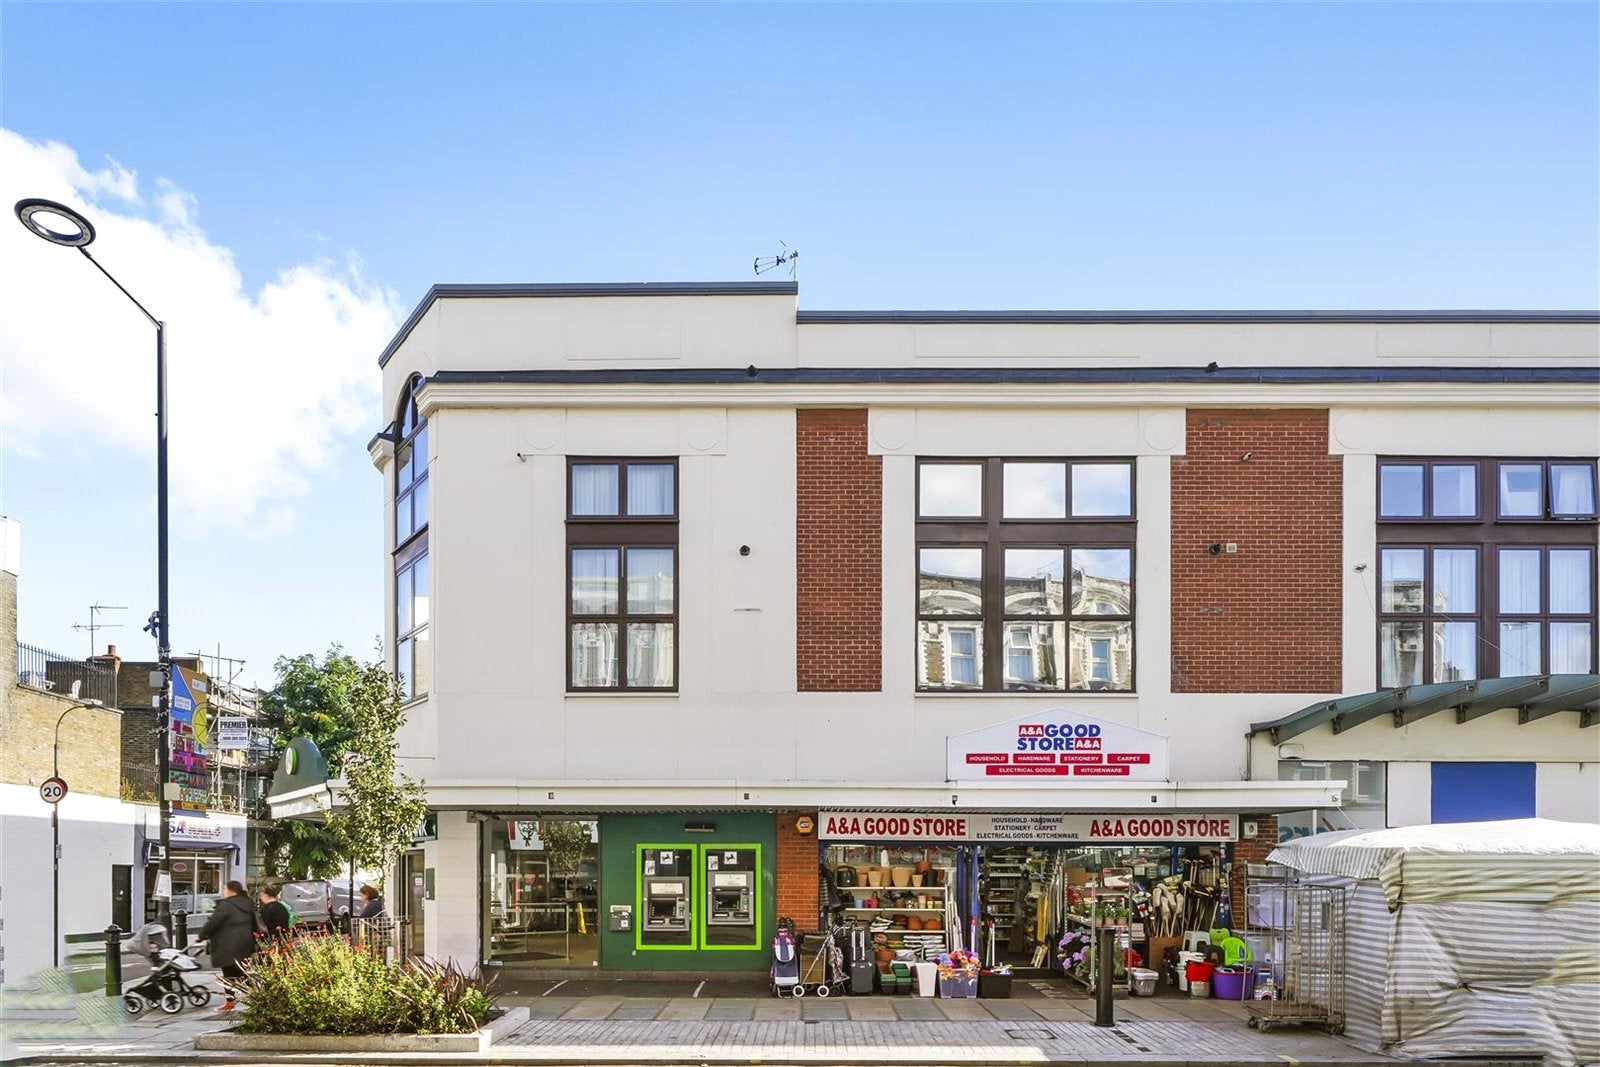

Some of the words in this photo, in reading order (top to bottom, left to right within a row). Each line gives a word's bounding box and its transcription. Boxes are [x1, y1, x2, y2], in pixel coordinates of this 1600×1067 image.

[220, 721, 247, 729] PREMIER
[1020, 726, 1043, 736] A&A
[1044, 724, 1101, 738] GOOD
[1017, 737, 1074, 751] STORE
[1076, 739, 1100, 749] A&A
[43, 786, 62, 798] 20
[826, 817, 861, 835] A&A
[863, 817, 910, 836] GOOD
[912, 818, 966, 837] STORE
[1089, 819, 1125, 837] A&A
[1127, 819, 1174, 837] GOOD
[1177, 819, 1230, 837] STORE
